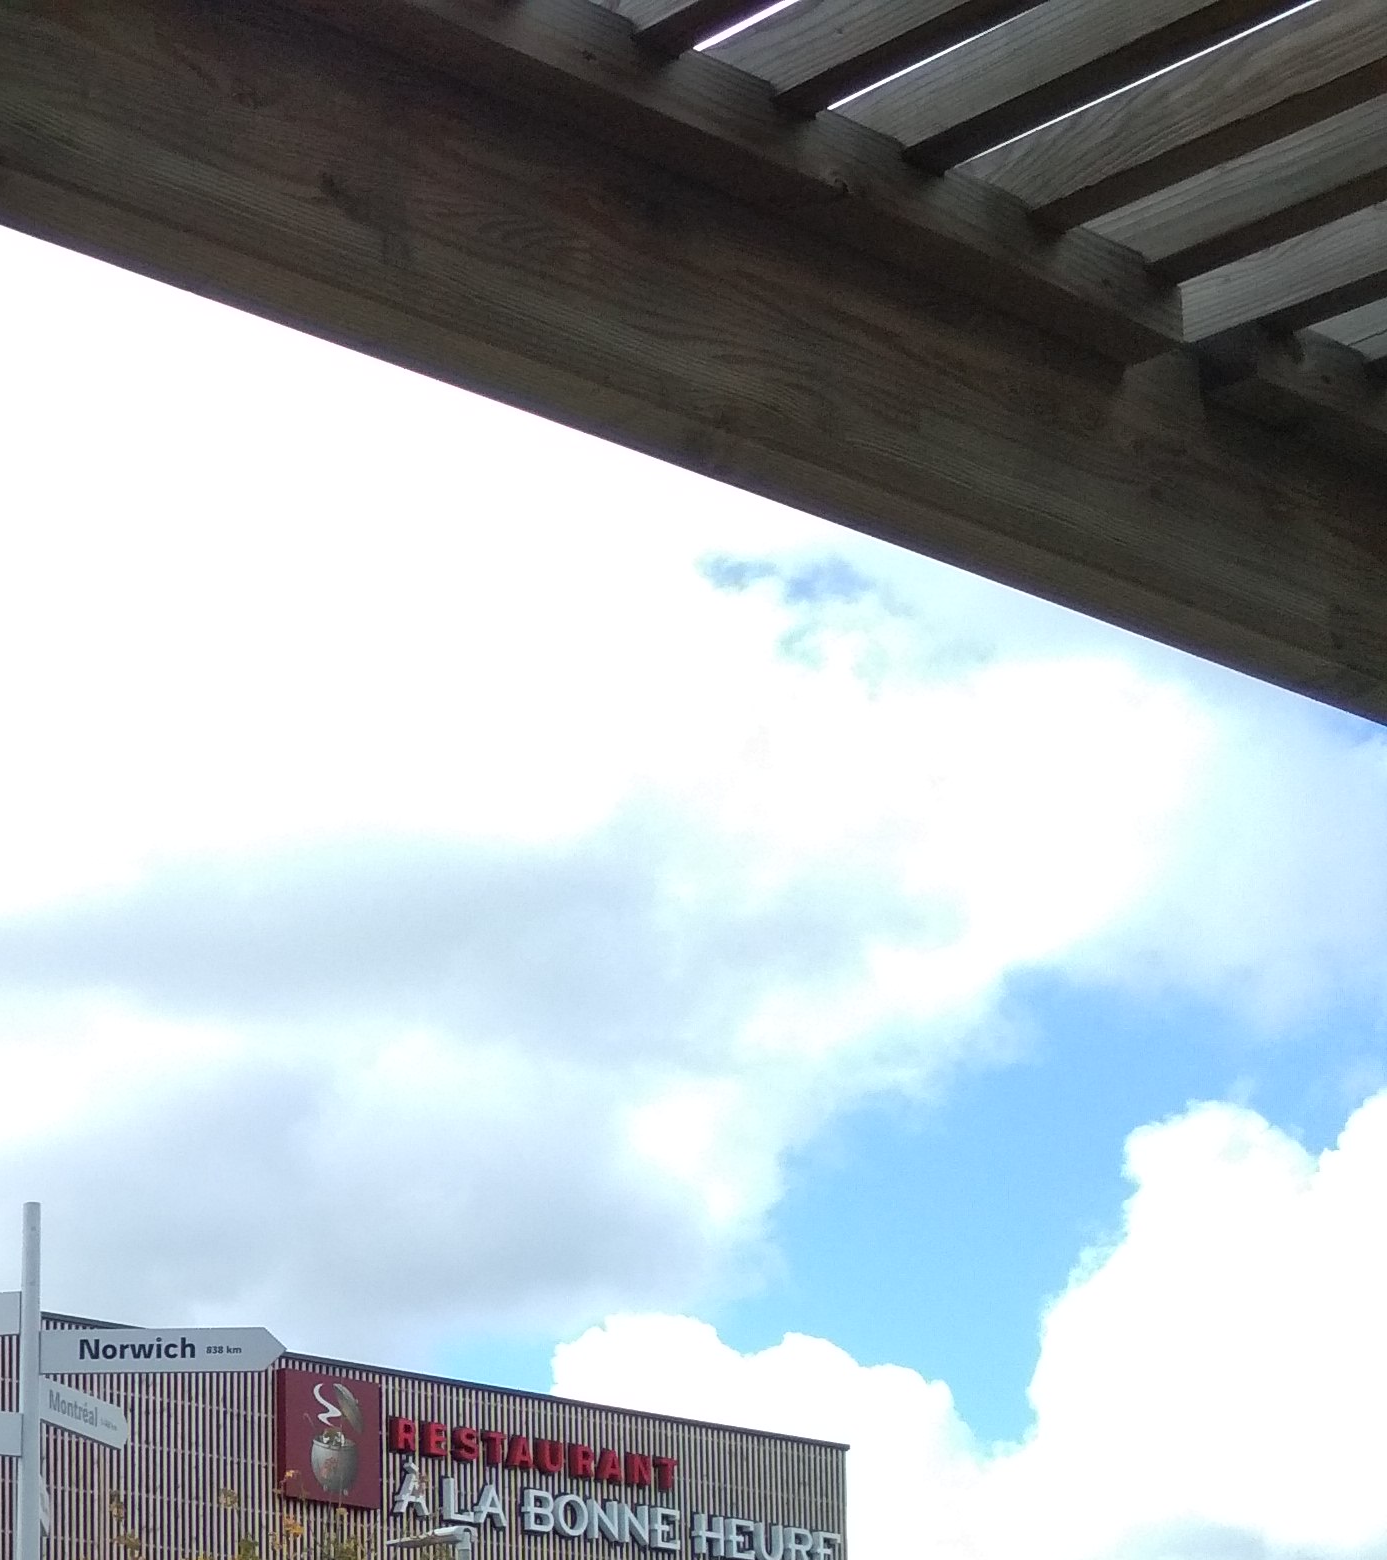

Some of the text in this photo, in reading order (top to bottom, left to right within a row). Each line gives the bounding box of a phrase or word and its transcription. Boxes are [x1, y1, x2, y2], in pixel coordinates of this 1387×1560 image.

[79, 1337, 242, 1360] Norwich 838 km
[49, 1389, 98, 1428] Montréal
[389, 1415, 677, 1493] RESTAURANT
[441, 1476, 508, 1528] LA
[521, 1487, 681, 1551] BONNE
